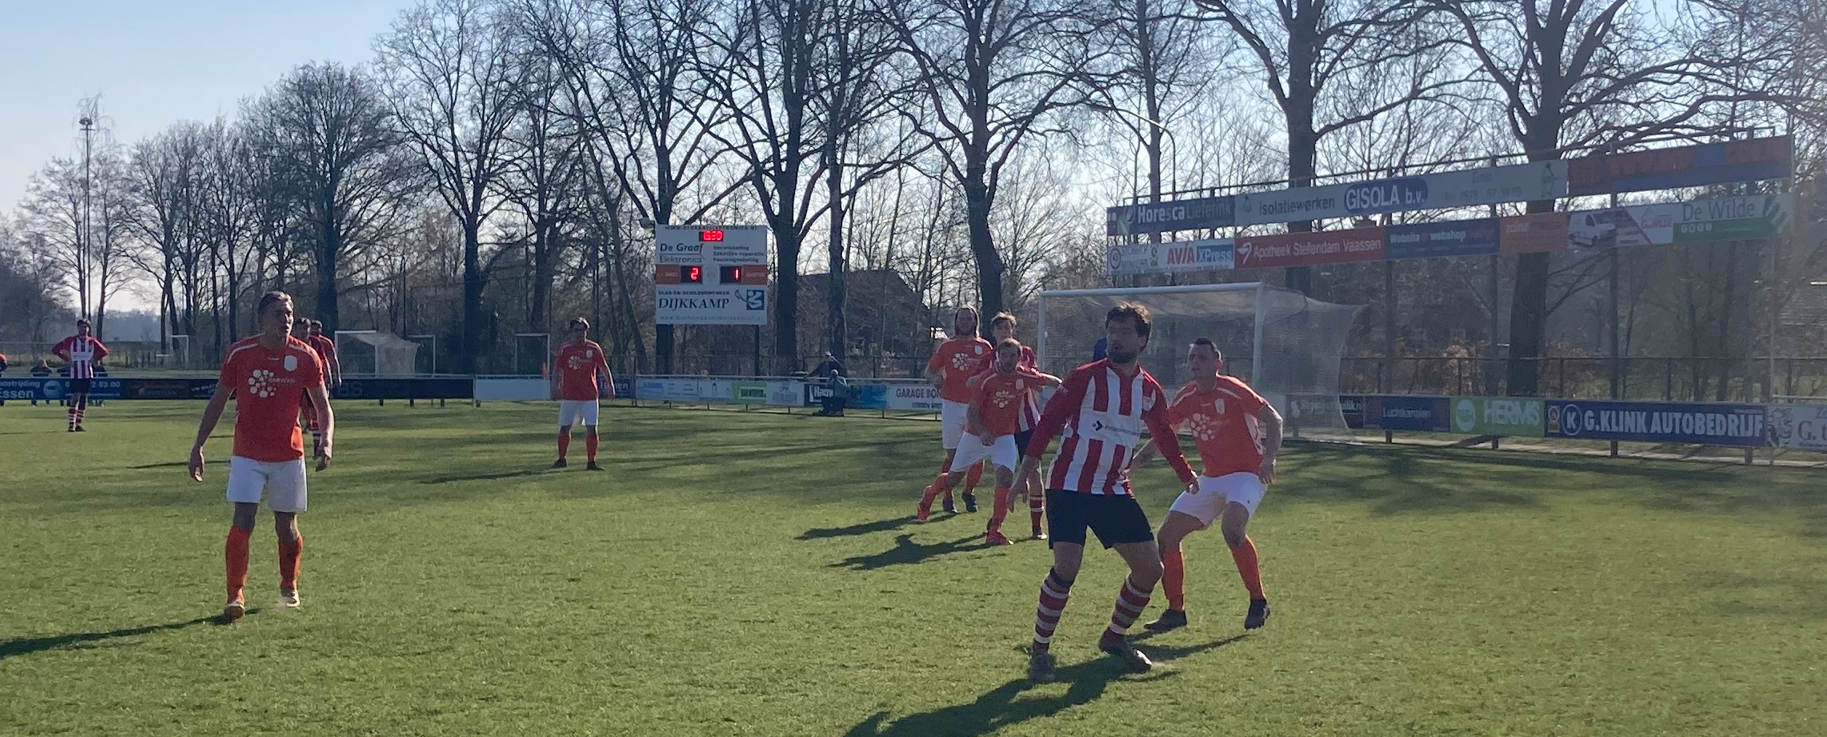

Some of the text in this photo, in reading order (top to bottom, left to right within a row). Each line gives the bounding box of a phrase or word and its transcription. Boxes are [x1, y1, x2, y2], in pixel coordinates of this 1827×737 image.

[1345, 185, 1400, 210] GISOLA
[1405, 188, 1425, 204] b.v.
[1137, 205, 1185, 224] Horesca
[1682, 197, 1756, 222] De Wilde
[1430, 230, 1466, 242] webshop
[660, 243, 704, 253] De Graaf
[1167, 244, 1195, 265] AVIA
[1197, 247, 1232, 263] XPress
[1253, 243, 1291, 261] Apotheek
[1342, 238, 1382, 253] Vaassen
[690, 267, 699, 280] 2
[735, 268, 739, 280] 1
[658, 298, 730, 311] DIJKKAMP
[0, 388, 34, 399] ssen
[896, 388, 925, 399] GARAGE
[1483, 400, 1540, 426] HERMS
[1566, 411, 1576, 429] K
[1650, 411, 1764, 437] AUTOBEDRIJF
